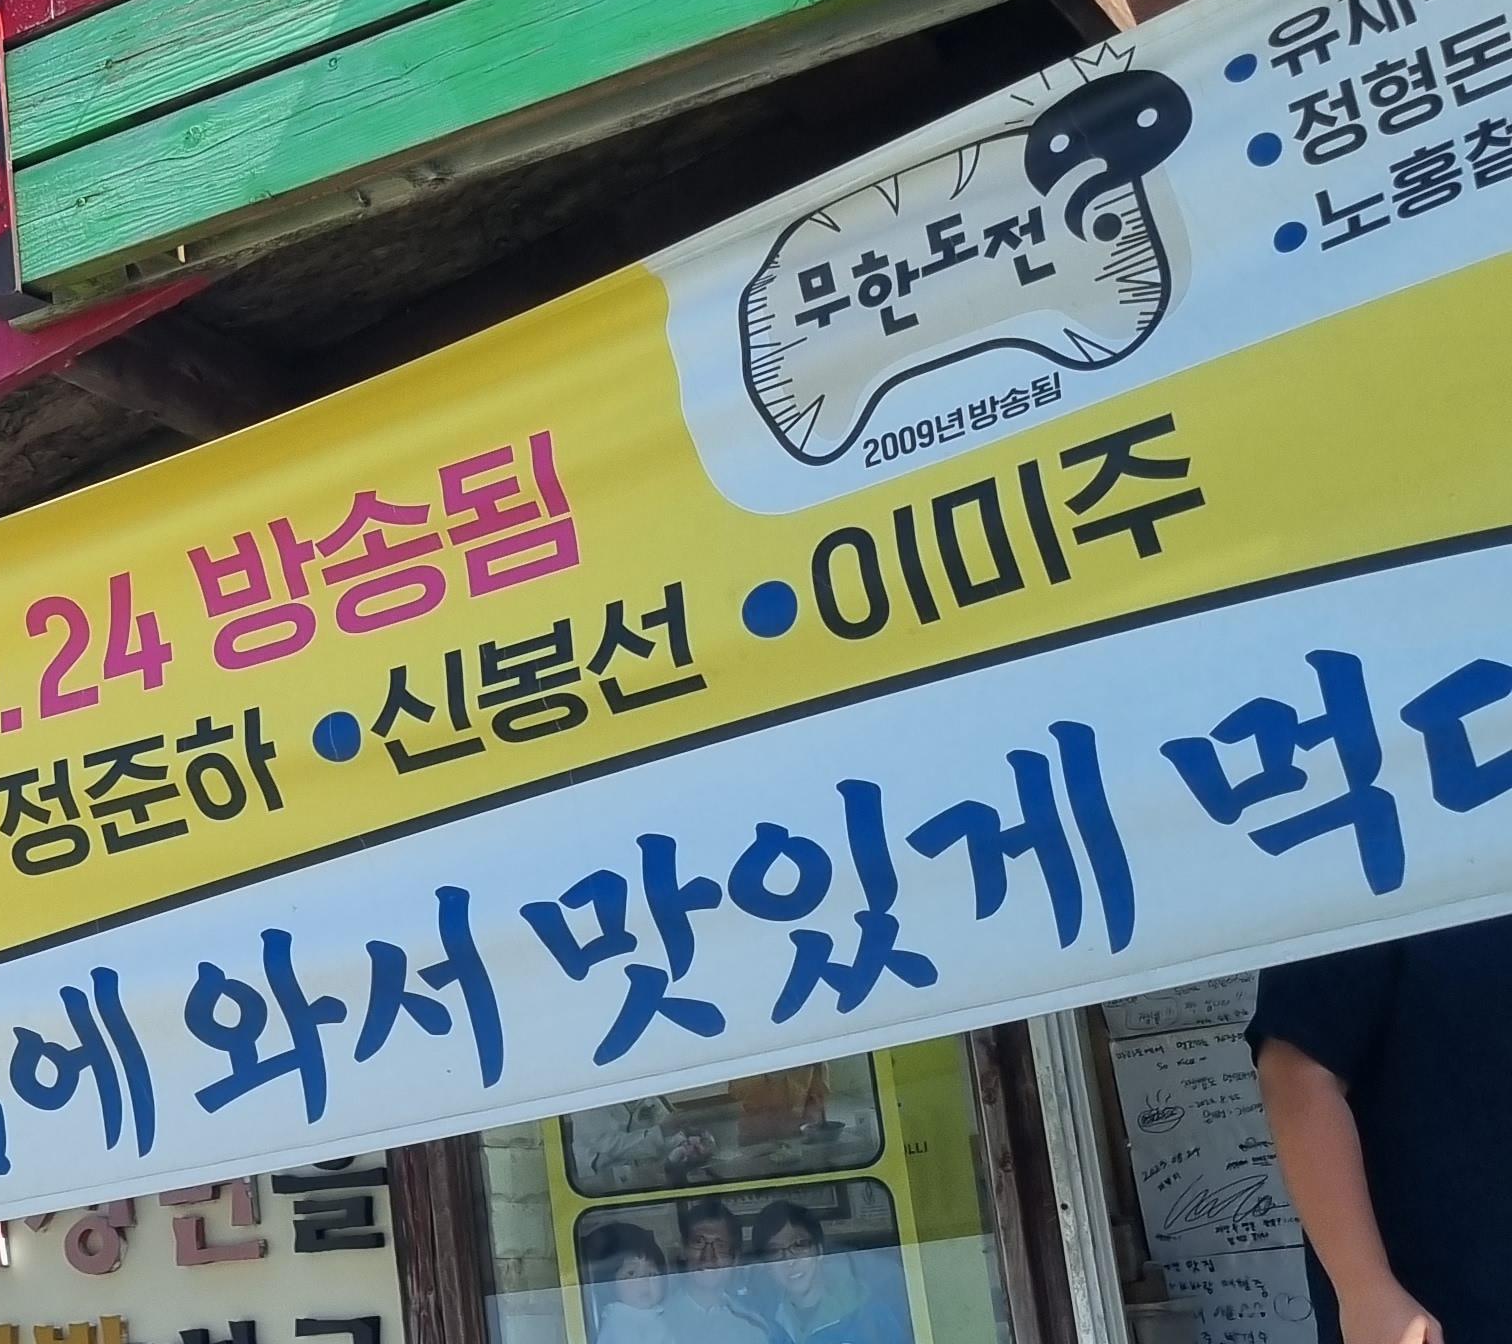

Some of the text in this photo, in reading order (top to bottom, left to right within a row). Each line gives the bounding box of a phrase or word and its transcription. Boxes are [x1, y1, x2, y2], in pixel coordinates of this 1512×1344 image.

[1288, 13, 1512, 165] 정형돈
[794, 205, 1057, 336] 무한도전
[188, 428, 581, 672] 방송됨
[369, 581, 706, 775] 신봉선
[811, 413, 1205, 642] 이미주
[184, 885, 505, 1126] 와서
[519, 720, 1137, 1068] 맛있게
